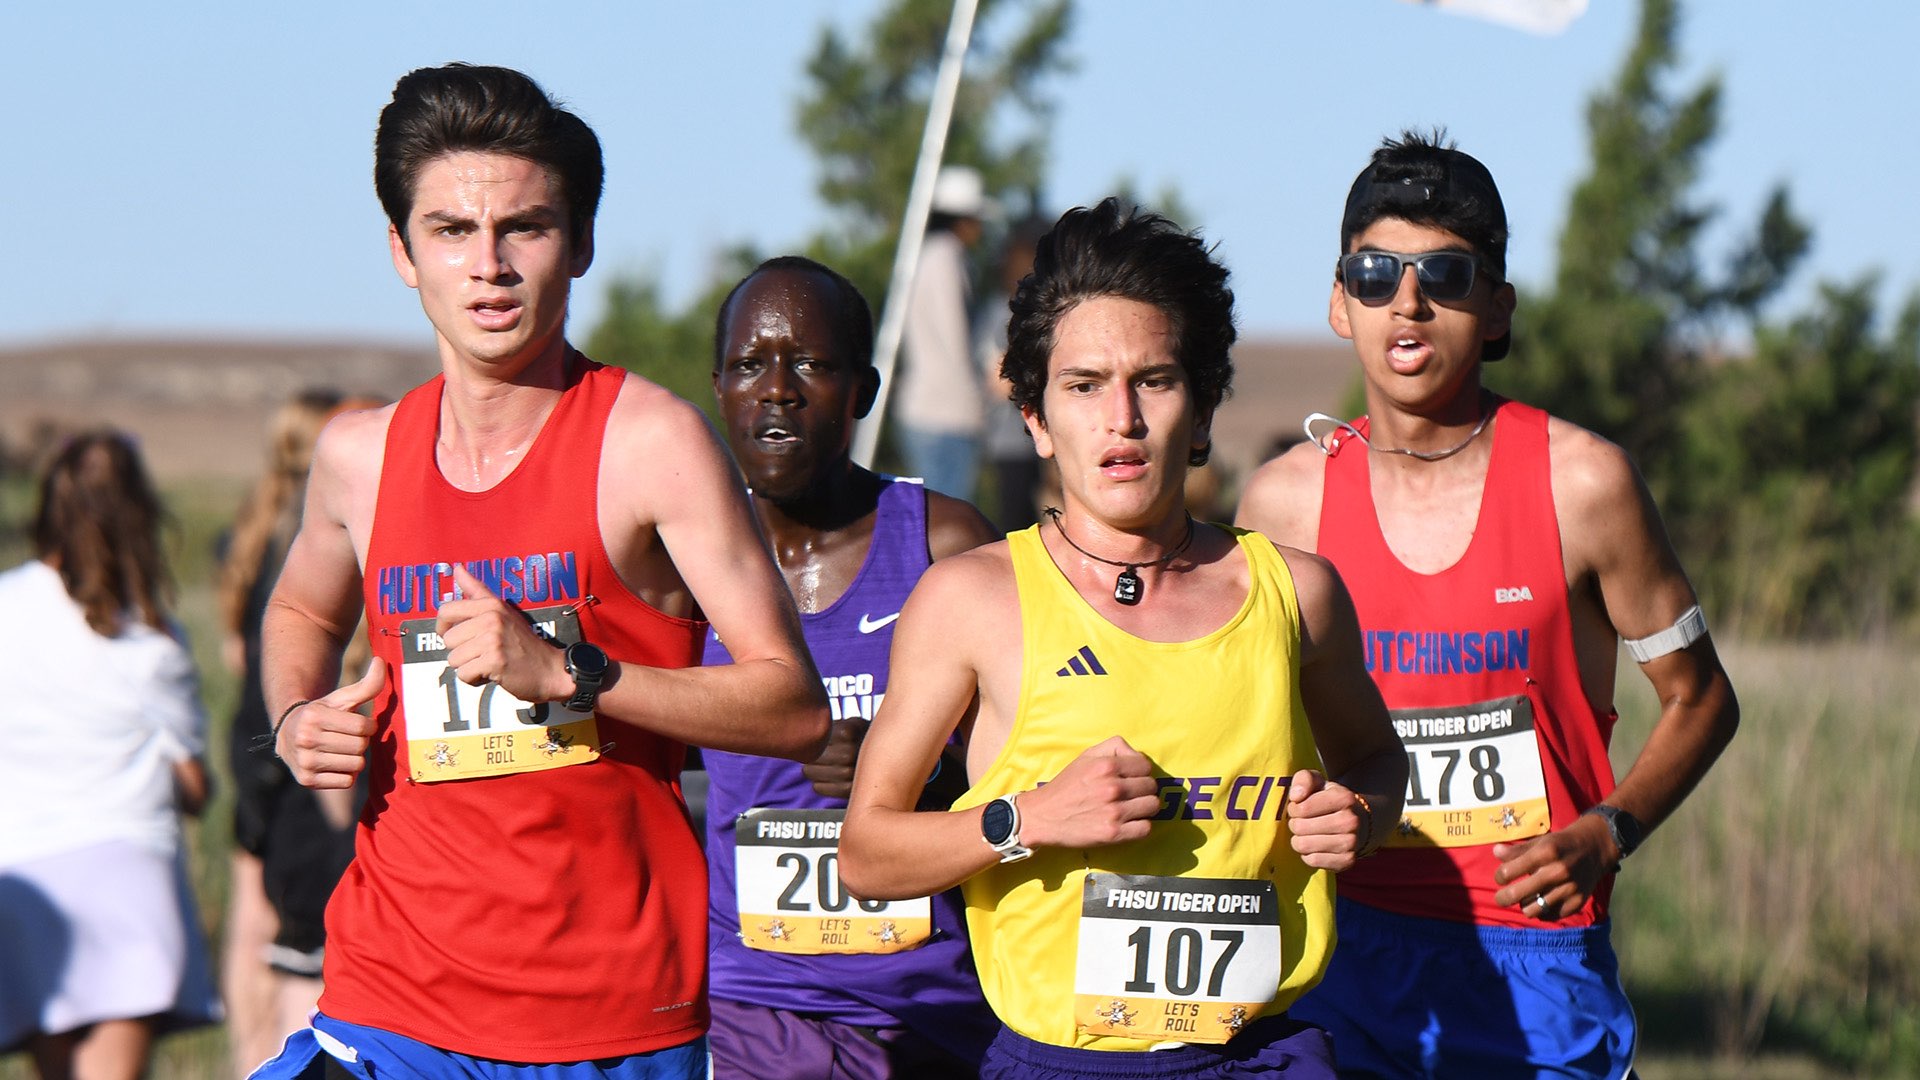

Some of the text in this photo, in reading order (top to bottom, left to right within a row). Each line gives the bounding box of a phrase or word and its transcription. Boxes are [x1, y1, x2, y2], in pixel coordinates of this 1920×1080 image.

[417, 620, 556, 652] FHS EN
[1361, 628, 1530, 676] UTCHINSON
[822, 673, 873, 698] ICO
[1392, 708, 1513, 738] SU TIGER OPEN
[483, 735, 514, 750] LET'S
[486, 750, 516, 765] ROLL
[1406, 744, 1506, 806] 178
[1226, 776, 1292, 821] CIT
[1443, 811, 1473, 824] LET'S
[757, 821, 844, 840] FHSU TIG
[1447, 824, 1473, 837] ROLL
[776, 852, 890, 912] 20
[1106, 888, 1261, 914] FHSU TIGER OPEN
[819, 919, 851, 932] LET'S
[821, 931, 850, 945] ROLL
[1124, 926, 1245, 997] 107
[1164, 1002, 1200, 1017] LET'S
[1165, 1017, 1196, 1032] ROLL
